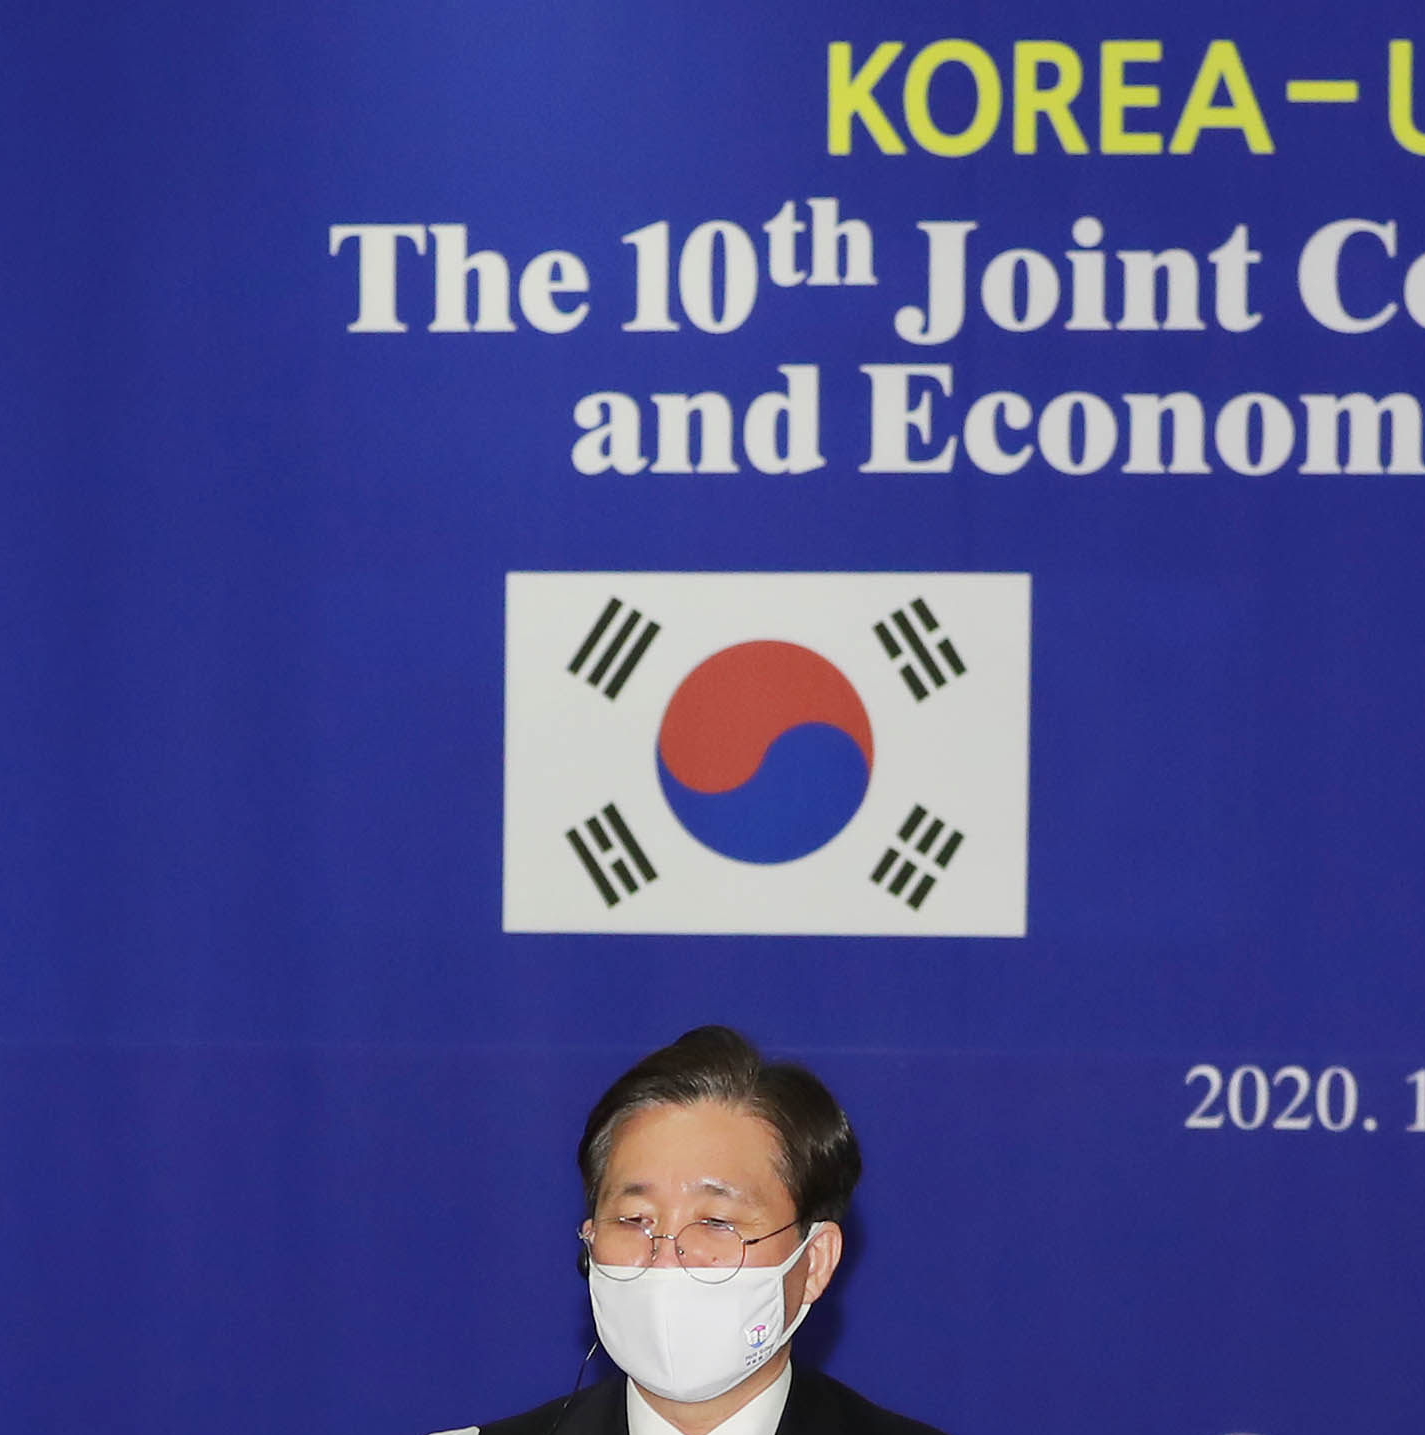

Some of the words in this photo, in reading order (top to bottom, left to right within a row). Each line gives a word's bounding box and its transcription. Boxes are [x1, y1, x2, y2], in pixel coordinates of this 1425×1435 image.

[329, 223, 591, 335] The
[620, 197, 879, 336] 10th
[893, 216, 1263, 347] Joint
[570, 363, 827, 477] and
[1184, 1064, 1378, 1133] 2020.
